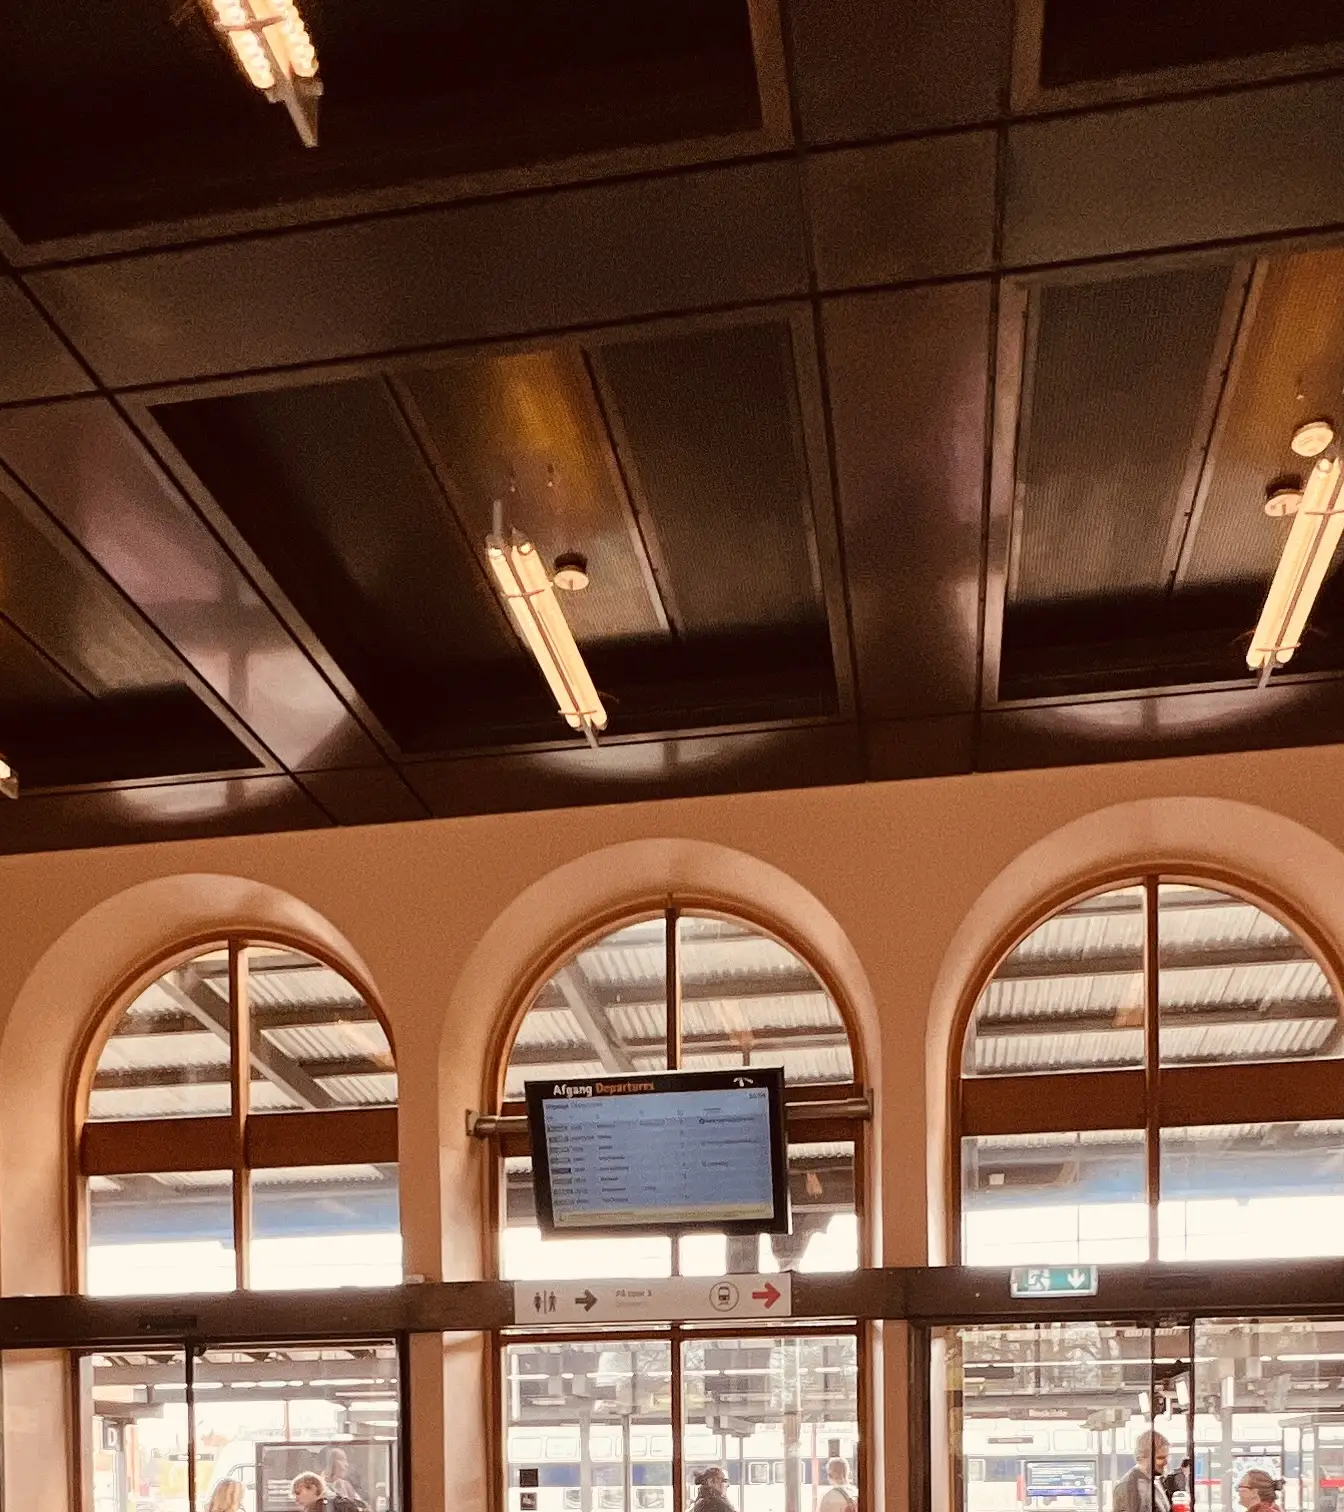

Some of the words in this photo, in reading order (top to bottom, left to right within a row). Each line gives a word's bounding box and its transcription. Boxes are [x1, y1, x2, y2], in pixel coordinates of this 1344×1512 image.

[553, 1083, 593, 1098] Afgang
[595, 1081, 655, 1095] Departures
[107, 1426, 119, 1447] D
